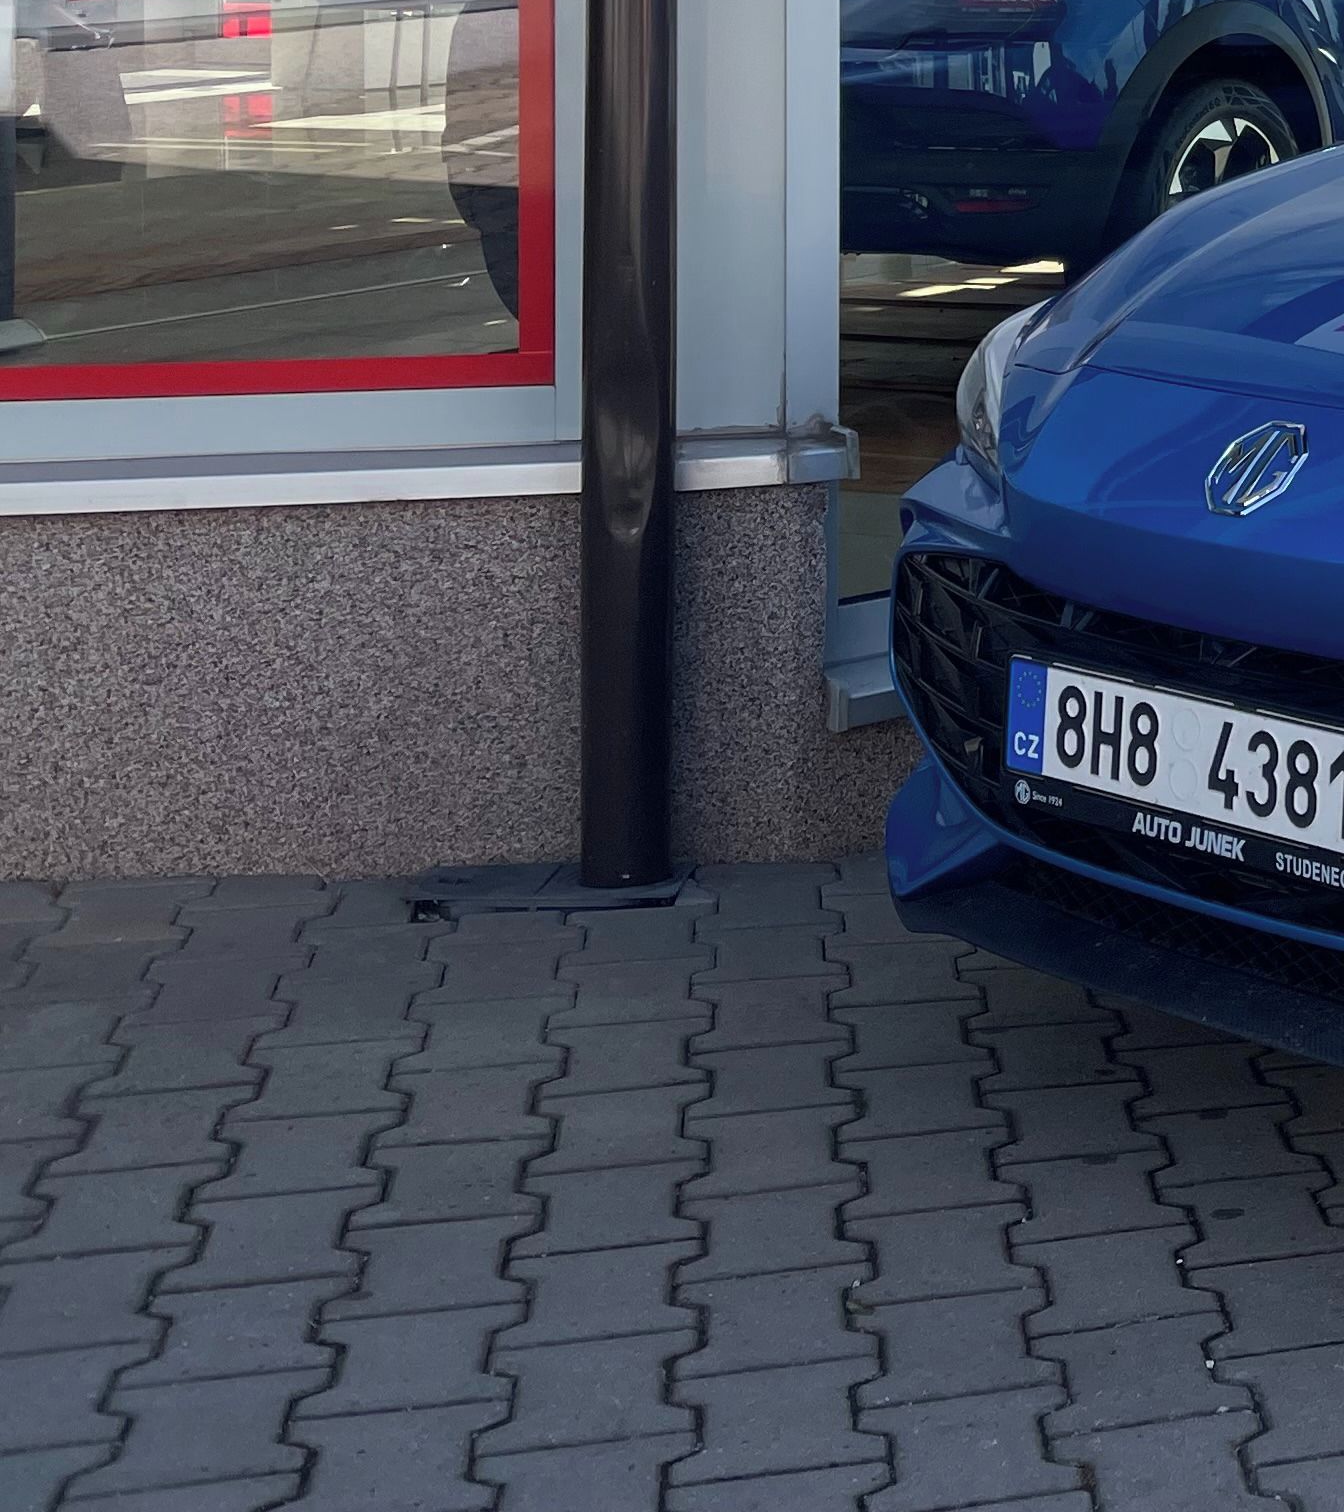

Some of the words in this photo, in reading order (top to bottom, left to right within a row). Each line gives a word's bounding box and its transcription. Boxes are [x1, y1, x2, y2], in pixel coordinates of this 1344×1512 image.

[1214, 429, 1299, 507] MG
[1013, 730, 1039, 760] CZ
[1055, 684, 1159, 787] 8H8
[1132, 811, 1182, 844] AUTO
[1185, 826, 1246, 862] JUNEK
